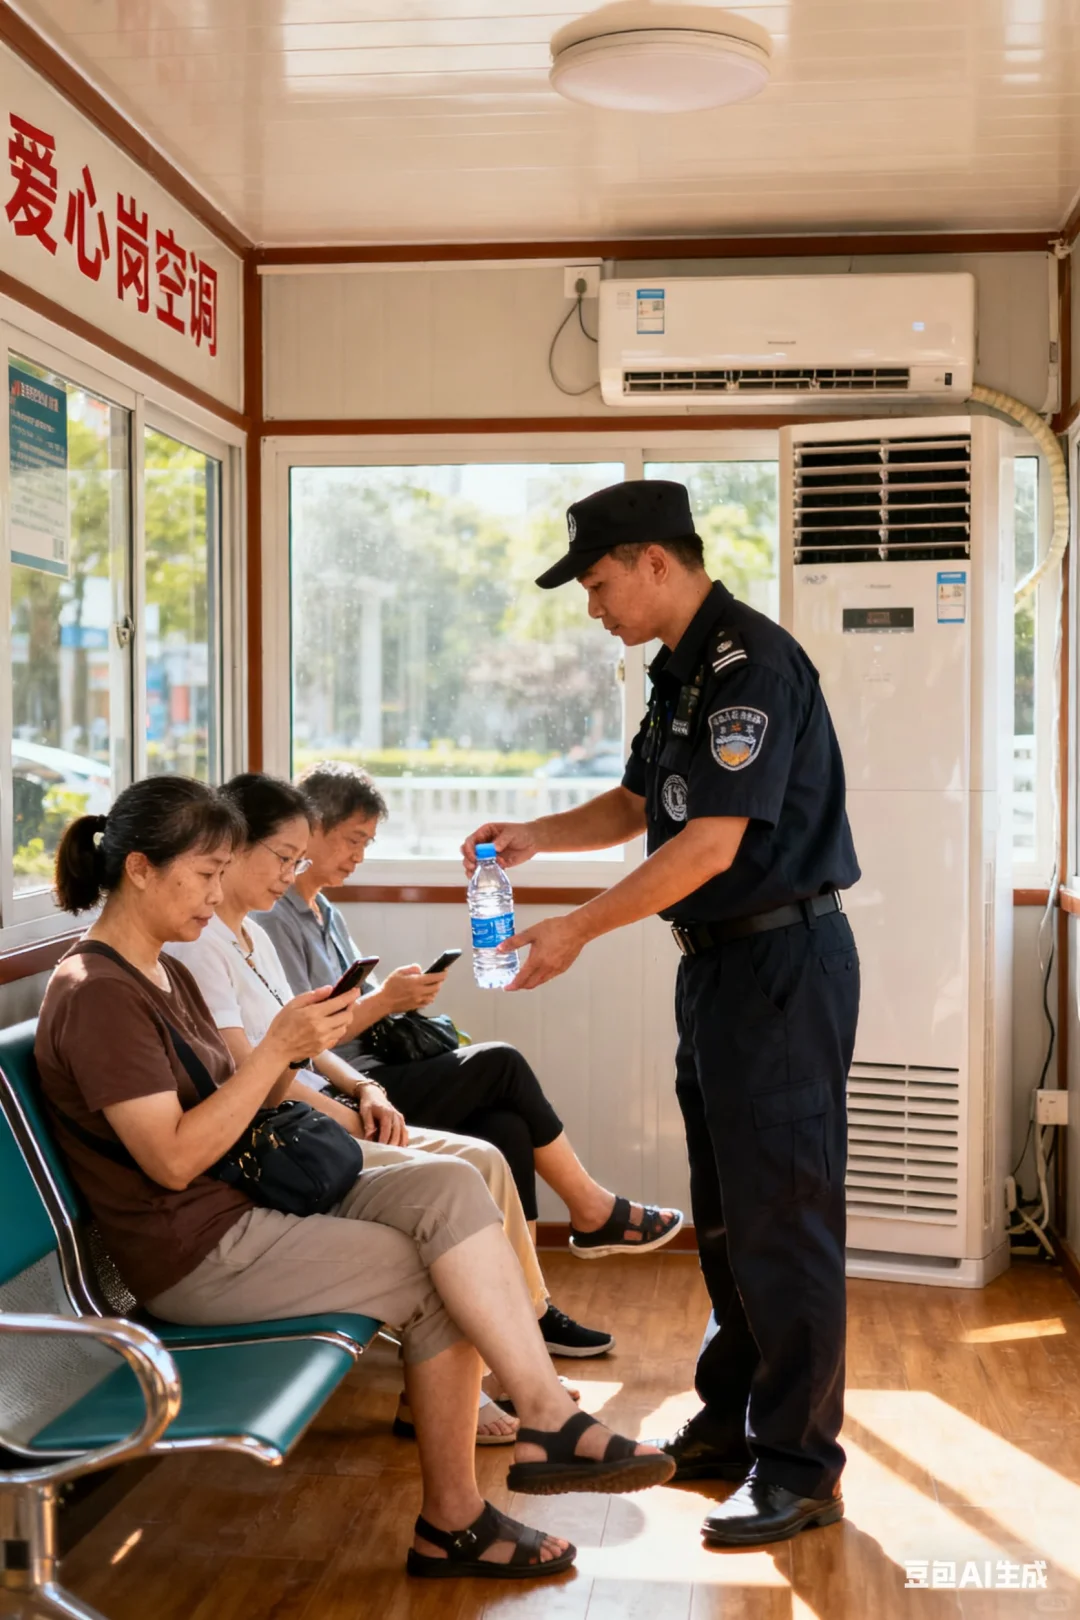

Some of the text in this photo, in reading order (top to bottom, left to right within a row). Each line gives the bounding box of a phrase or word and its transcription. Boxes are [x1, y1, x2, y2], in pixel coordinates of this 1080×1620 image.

[4, 111, 218, 357] 爱心岗空调
